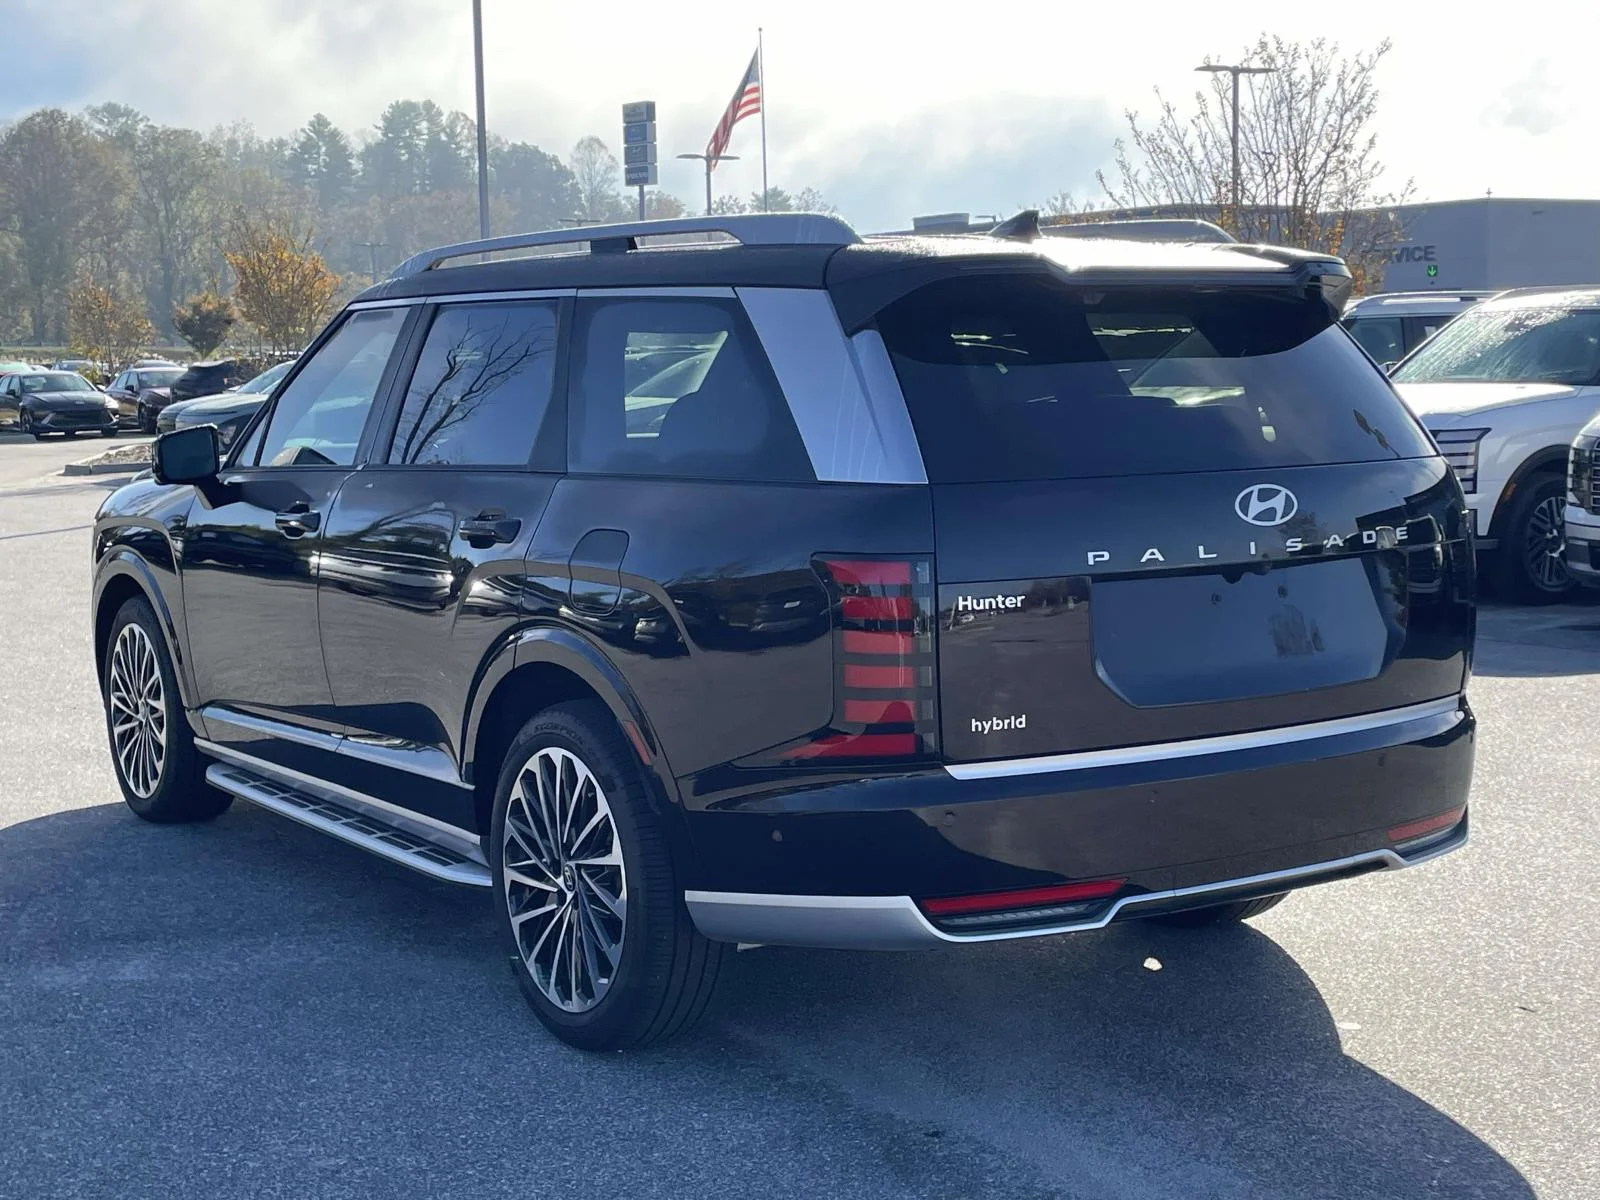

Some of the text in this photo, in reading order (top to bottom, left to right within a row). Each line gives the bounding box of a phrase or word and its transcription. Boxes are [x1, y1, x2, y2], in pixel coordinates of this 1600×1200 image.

[1087, 526, 1408, 565] PALISADE
[958, 594, 1025, 611] Hunter
[971, 714, 1026, 735] hybrid
